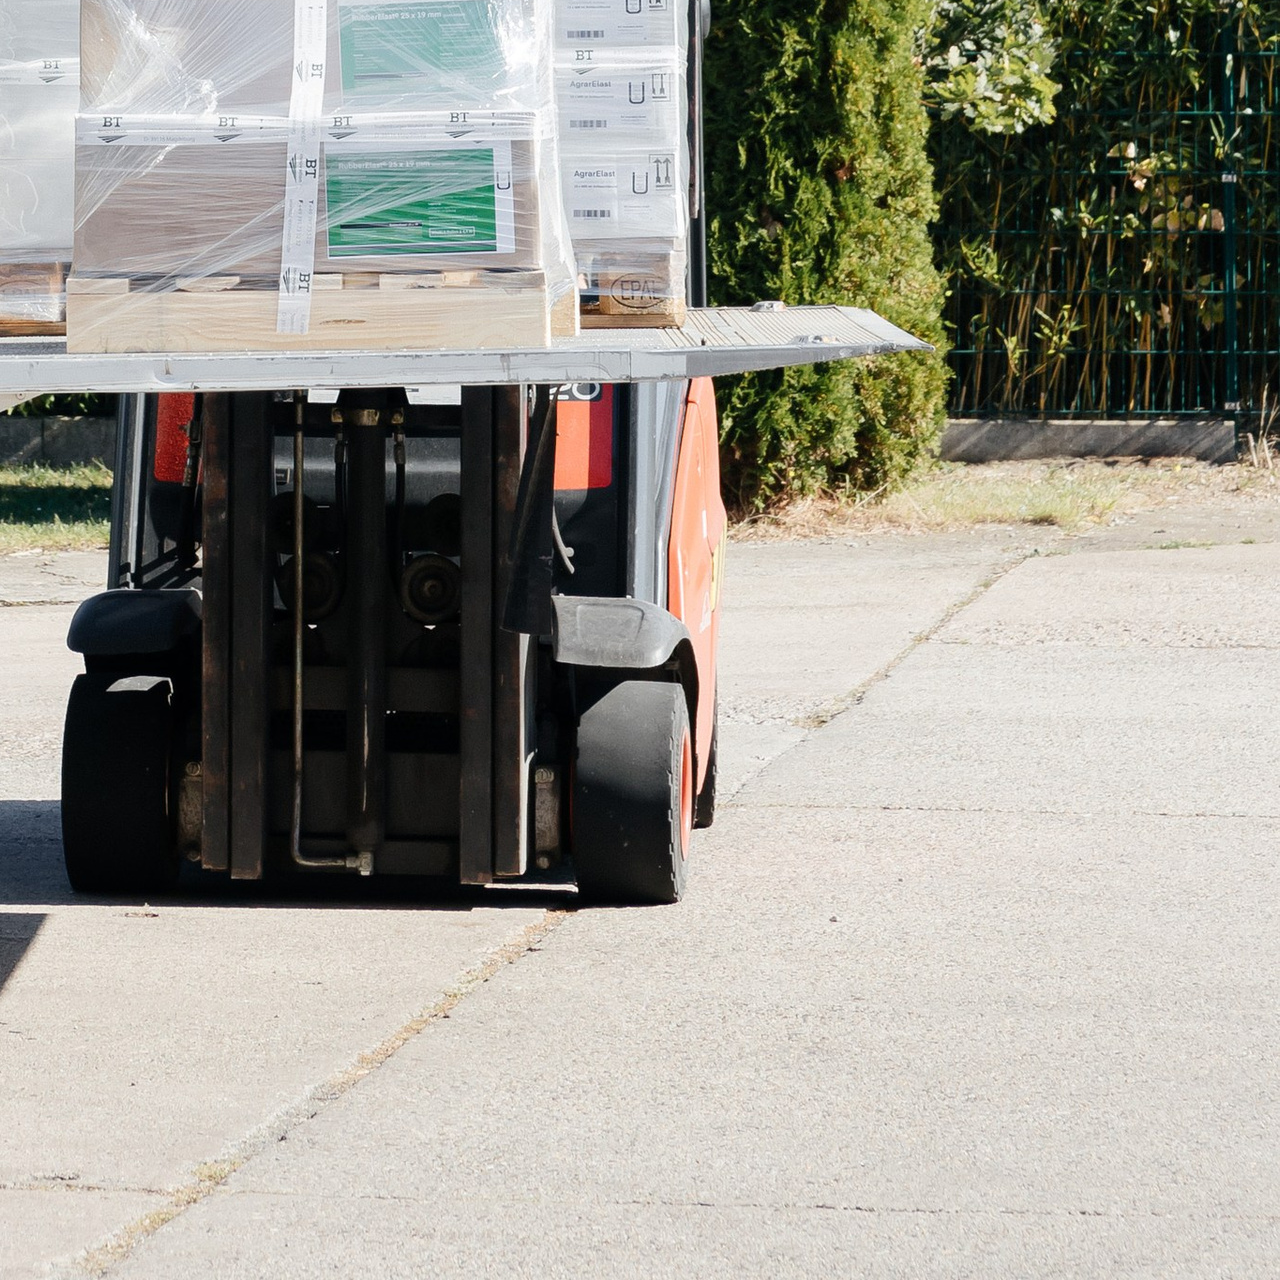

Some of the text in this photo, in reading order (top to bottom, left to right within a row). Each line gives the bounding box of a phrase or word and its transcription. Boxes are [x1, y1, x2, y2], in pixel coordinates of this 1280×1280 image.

[400, 12, 410, 20] 25
[575, 50, 593, 61] BT
[43, 60, 61, 69] BT
[311, 63, 322, 79] BT
[570, 80, 611, 88] AgrarElast
[102, 117, 123, 127] BT
[218, 117, 238, 127] BT
[333, 116, 353, 127] BT
[449, 112, 469, 123] BT
[305, 158, 317, 178] BT
[574, 170, 615, 179] AgrarElast
[299, 273, 311, 294] BT
